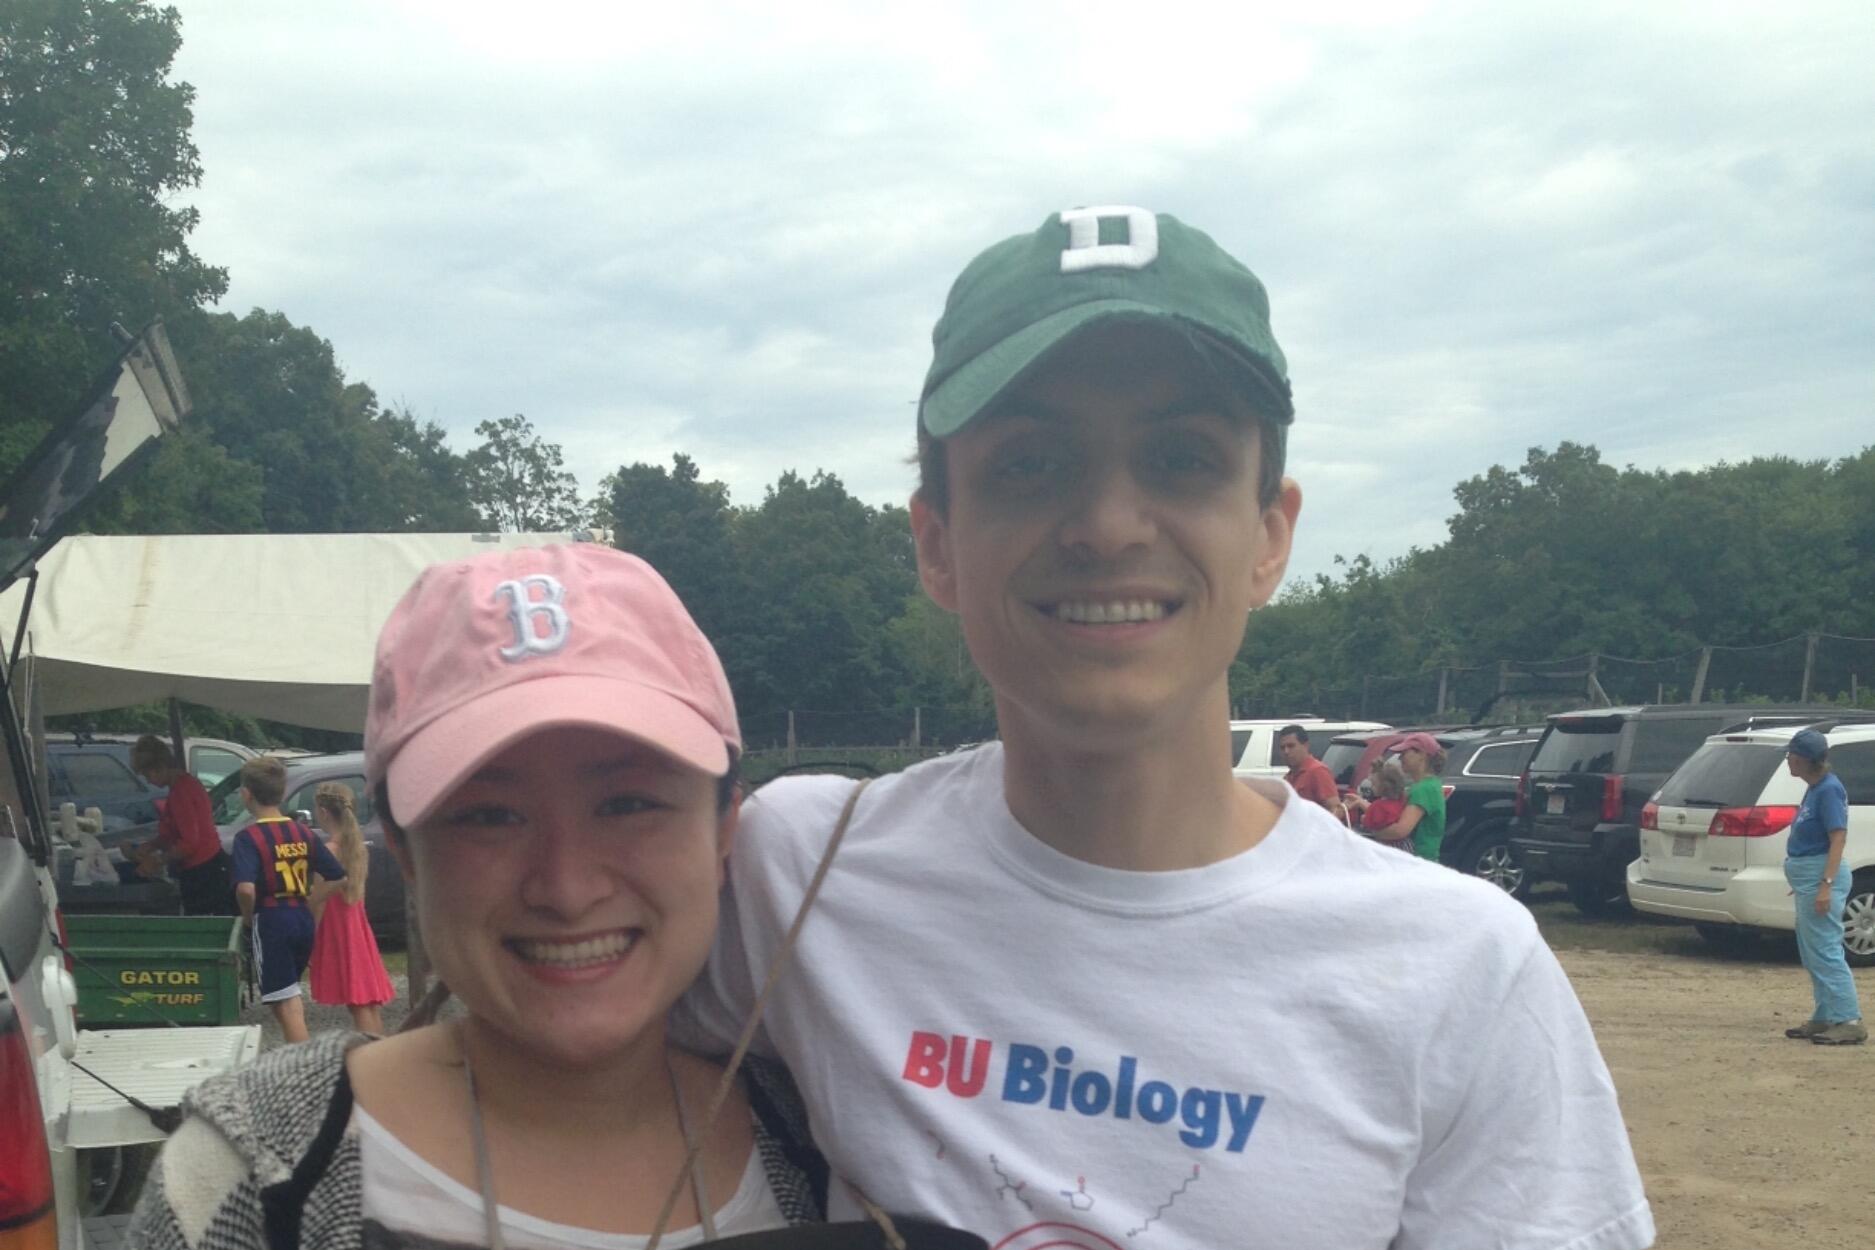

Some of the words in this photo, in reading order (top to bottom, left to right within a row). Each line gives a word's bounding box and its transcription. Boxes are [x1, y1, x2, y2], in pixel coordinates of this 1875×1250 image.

[1060, 204, 1159, 273] D
[496, 574, 573, 664] B
[274, 841, 307, 858] MESSI
[275, 859, 308, 896] 10
[121, 970, 200, 984] GATOR
[154, 993, 205, 1005] TURF
[902, 1030, 992, 1099] BU
[1001, 1042, 1265, 1153] Biology
